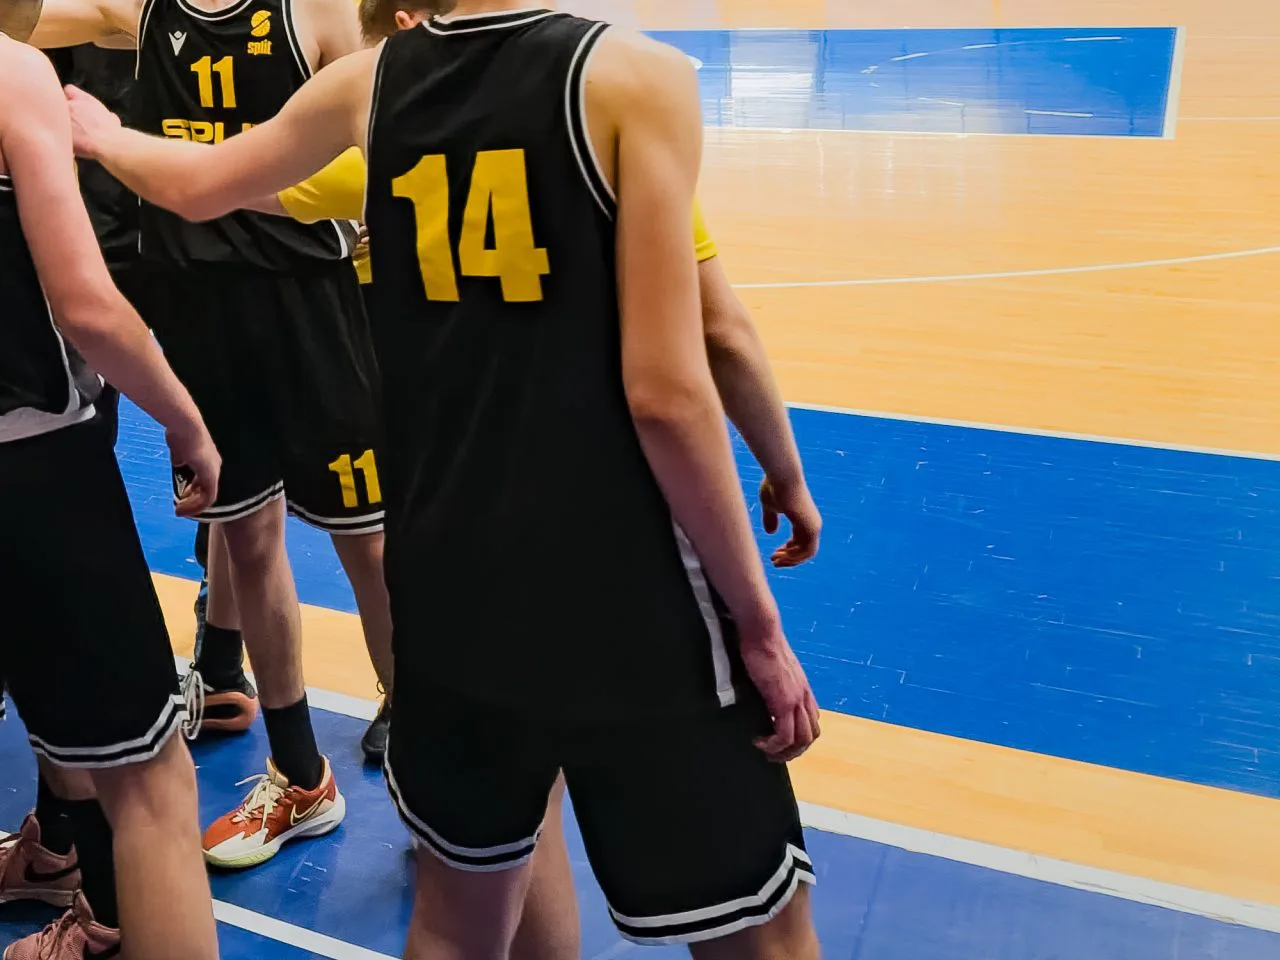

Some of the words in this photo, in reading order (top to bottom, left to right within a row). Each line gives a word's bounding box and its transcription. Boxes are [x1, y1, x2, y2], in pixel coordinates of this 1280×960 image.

[246, 39, 273, 56] split
[190, 55, 237, 109] 11
[392, 148, 551, 302] 14
[328, 448, 383, 508] 11
